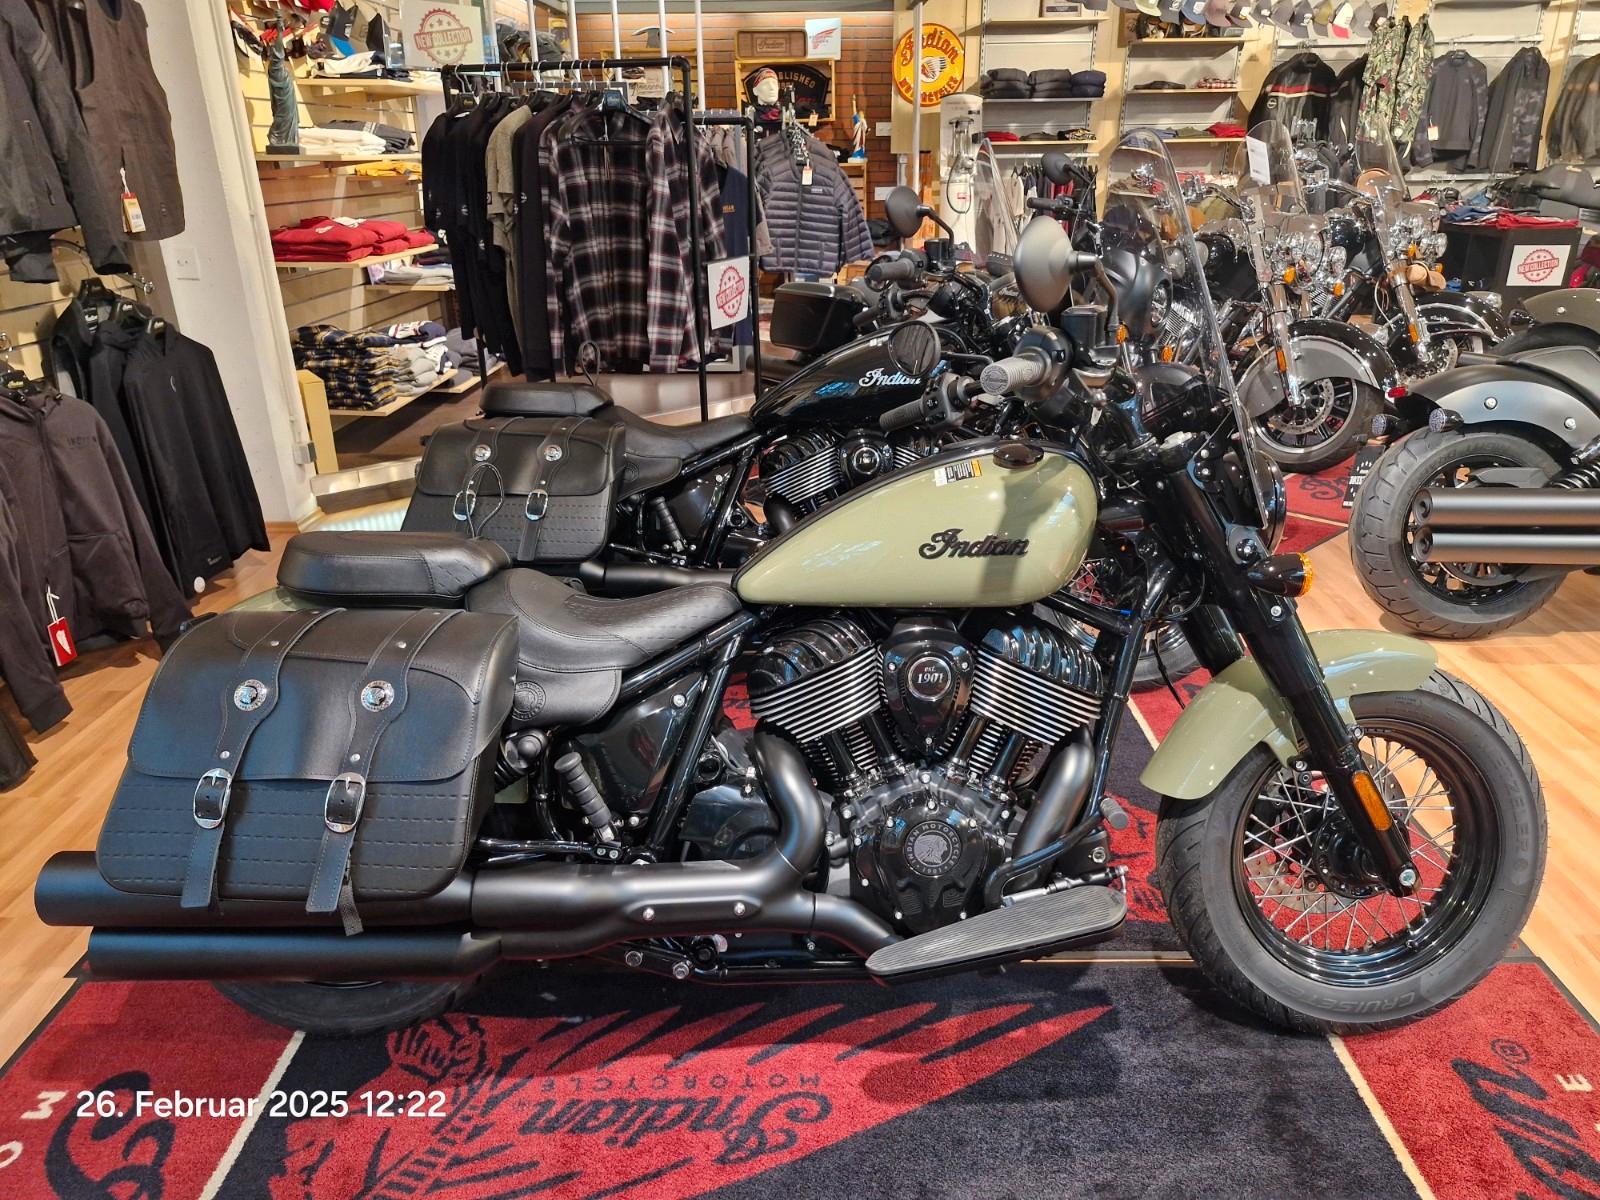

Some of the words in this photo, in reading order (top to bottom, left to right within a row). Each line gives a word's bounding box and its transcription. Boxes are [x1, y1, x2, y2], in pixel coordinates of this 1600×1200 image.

[415, 32, 432, 48] NEW
[432, 29, 471, 46] COLLECTION
[901, 28, 959, 67] Idian
[778, 71, 816, 89] BLISHED
[1530, 258, 1559, 271] COLLECTION
[918, 528, 1030, 560] Indian
[916, 672, 944, 684] 1901
[924, 665, 937, 673] est.
[906, 829, 921, 866] INDIAN
[921, 823, 961, 867] MOTORCYCLE
[922, 866, 943, 875] 1901
[540, 1073, 820, 1093] MOTORCYCLE
[518, 1092, 833, 1166] Indian
